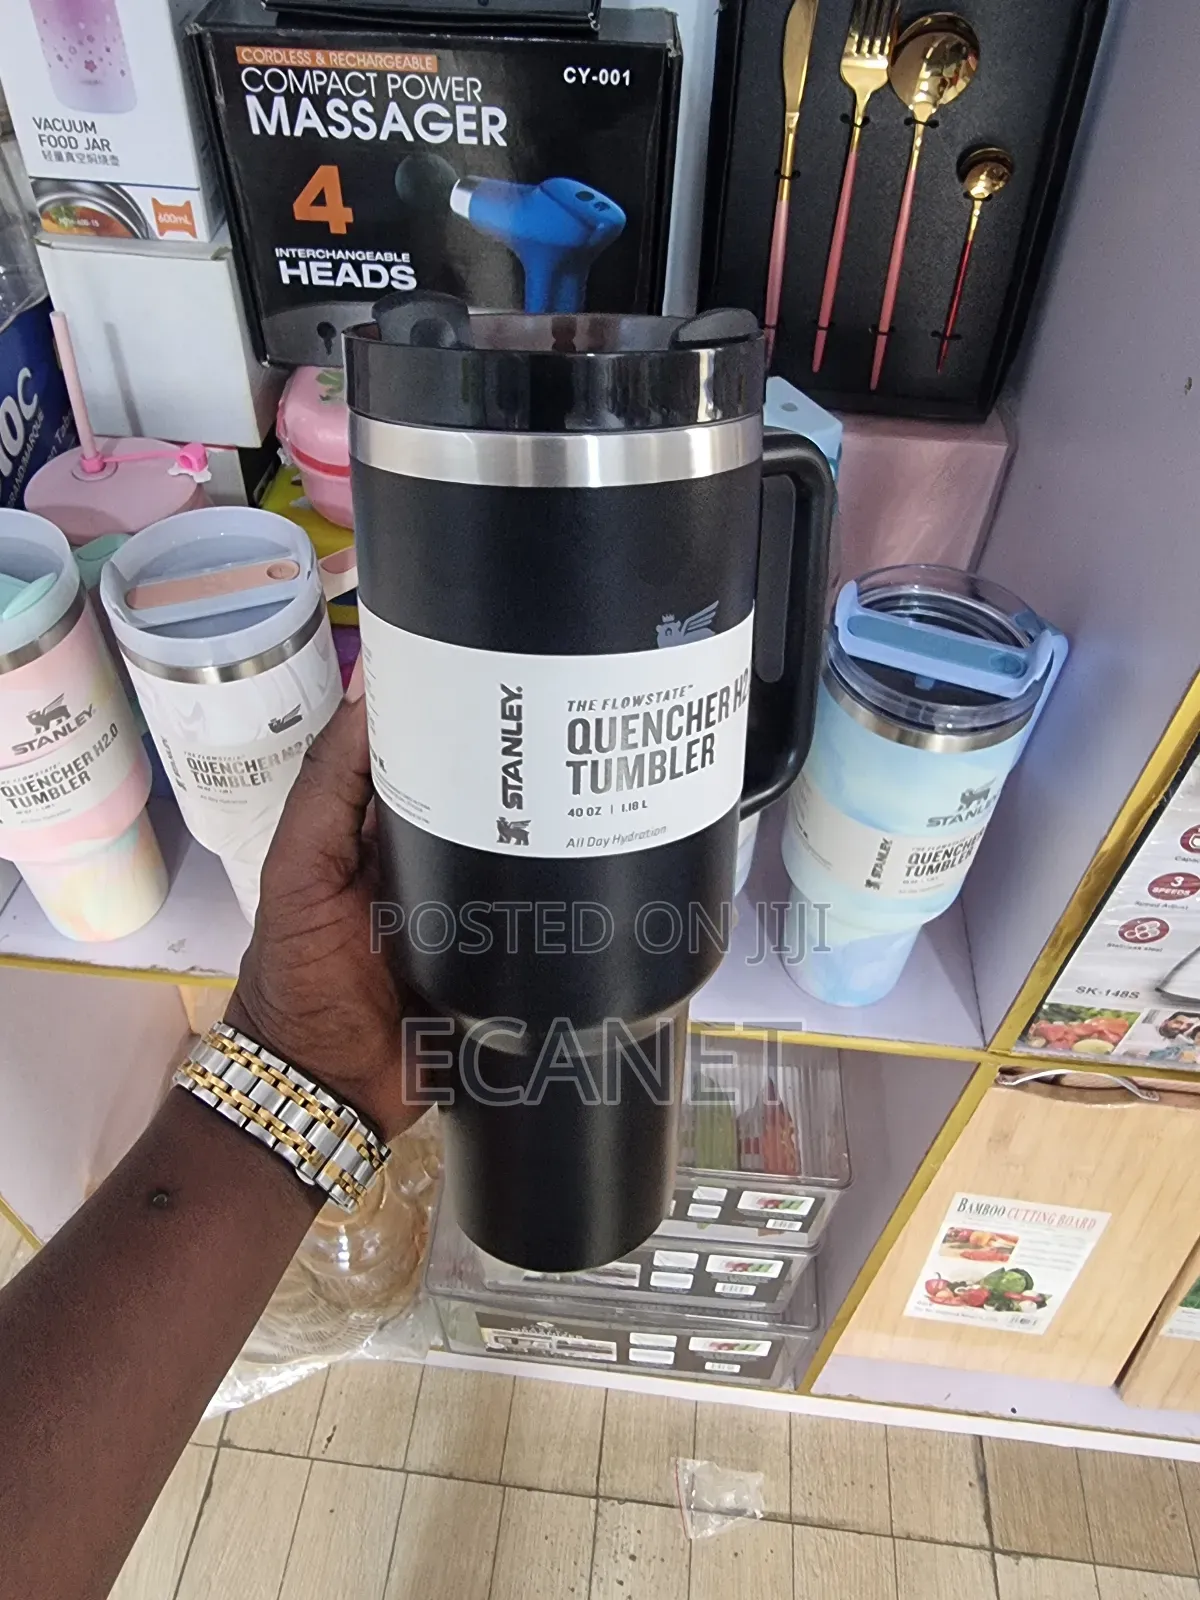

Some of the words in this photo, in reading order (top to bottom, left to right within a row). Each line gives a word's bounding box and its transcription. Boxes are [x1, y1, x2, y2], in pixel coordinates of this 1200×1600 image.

[241, 48, 312, 65] CORDLESS
[315, 52, 326, 66] &
[328, 53, 434, 72] RECHARGEABLE
[240, 66, 378, 97] COMPACT
[387, 72, 482, 103] POWER
[563, 66, 632, 87] CY-001
[32, 116, 98, 135] VACUUM
[245, 94, 508, 147] MASSAGER
[37, 133, 79, 151] FOOD
[84, 137, 112, 153] JAR
[292, 164, 355, 235] 4
[274, 246, 411, 263] INTERCHANGEABLE
[277, 261, 418, 291] HEADS
[566, 700, 598, 713] THE
[11, 702, 94, 757] STANLEY
[566, 685, 731, 756] QUENCHER
[0, 750, 94, 798] QUENCHER
[92, 722, 119, 758] H2.0
[186, 752, 282, 775] QUENCHER
[565, 732, 716, 797] TUMBLER
[6, 769, 92, 810] TUMBLER
[190, 769, 274, 788] TUMBLER
[567, 808, 585, 818] 40
[587, 806, 602, 817] OZ
[621, 802, 640, 814] 1.18
[641, 800, 649, 810] L
[565, 836, 585, 849] All
[587, 835, 609, 849] Day
[612, 824, 668, 847] Hydration
[1170, 876, 1185, 887] 3
[1075, 985, 1141, 1000] SK-148S
[1007, 1207, 1057, 1226] CUTTING
[1057, 1214, 1098, 1231] BOARD
